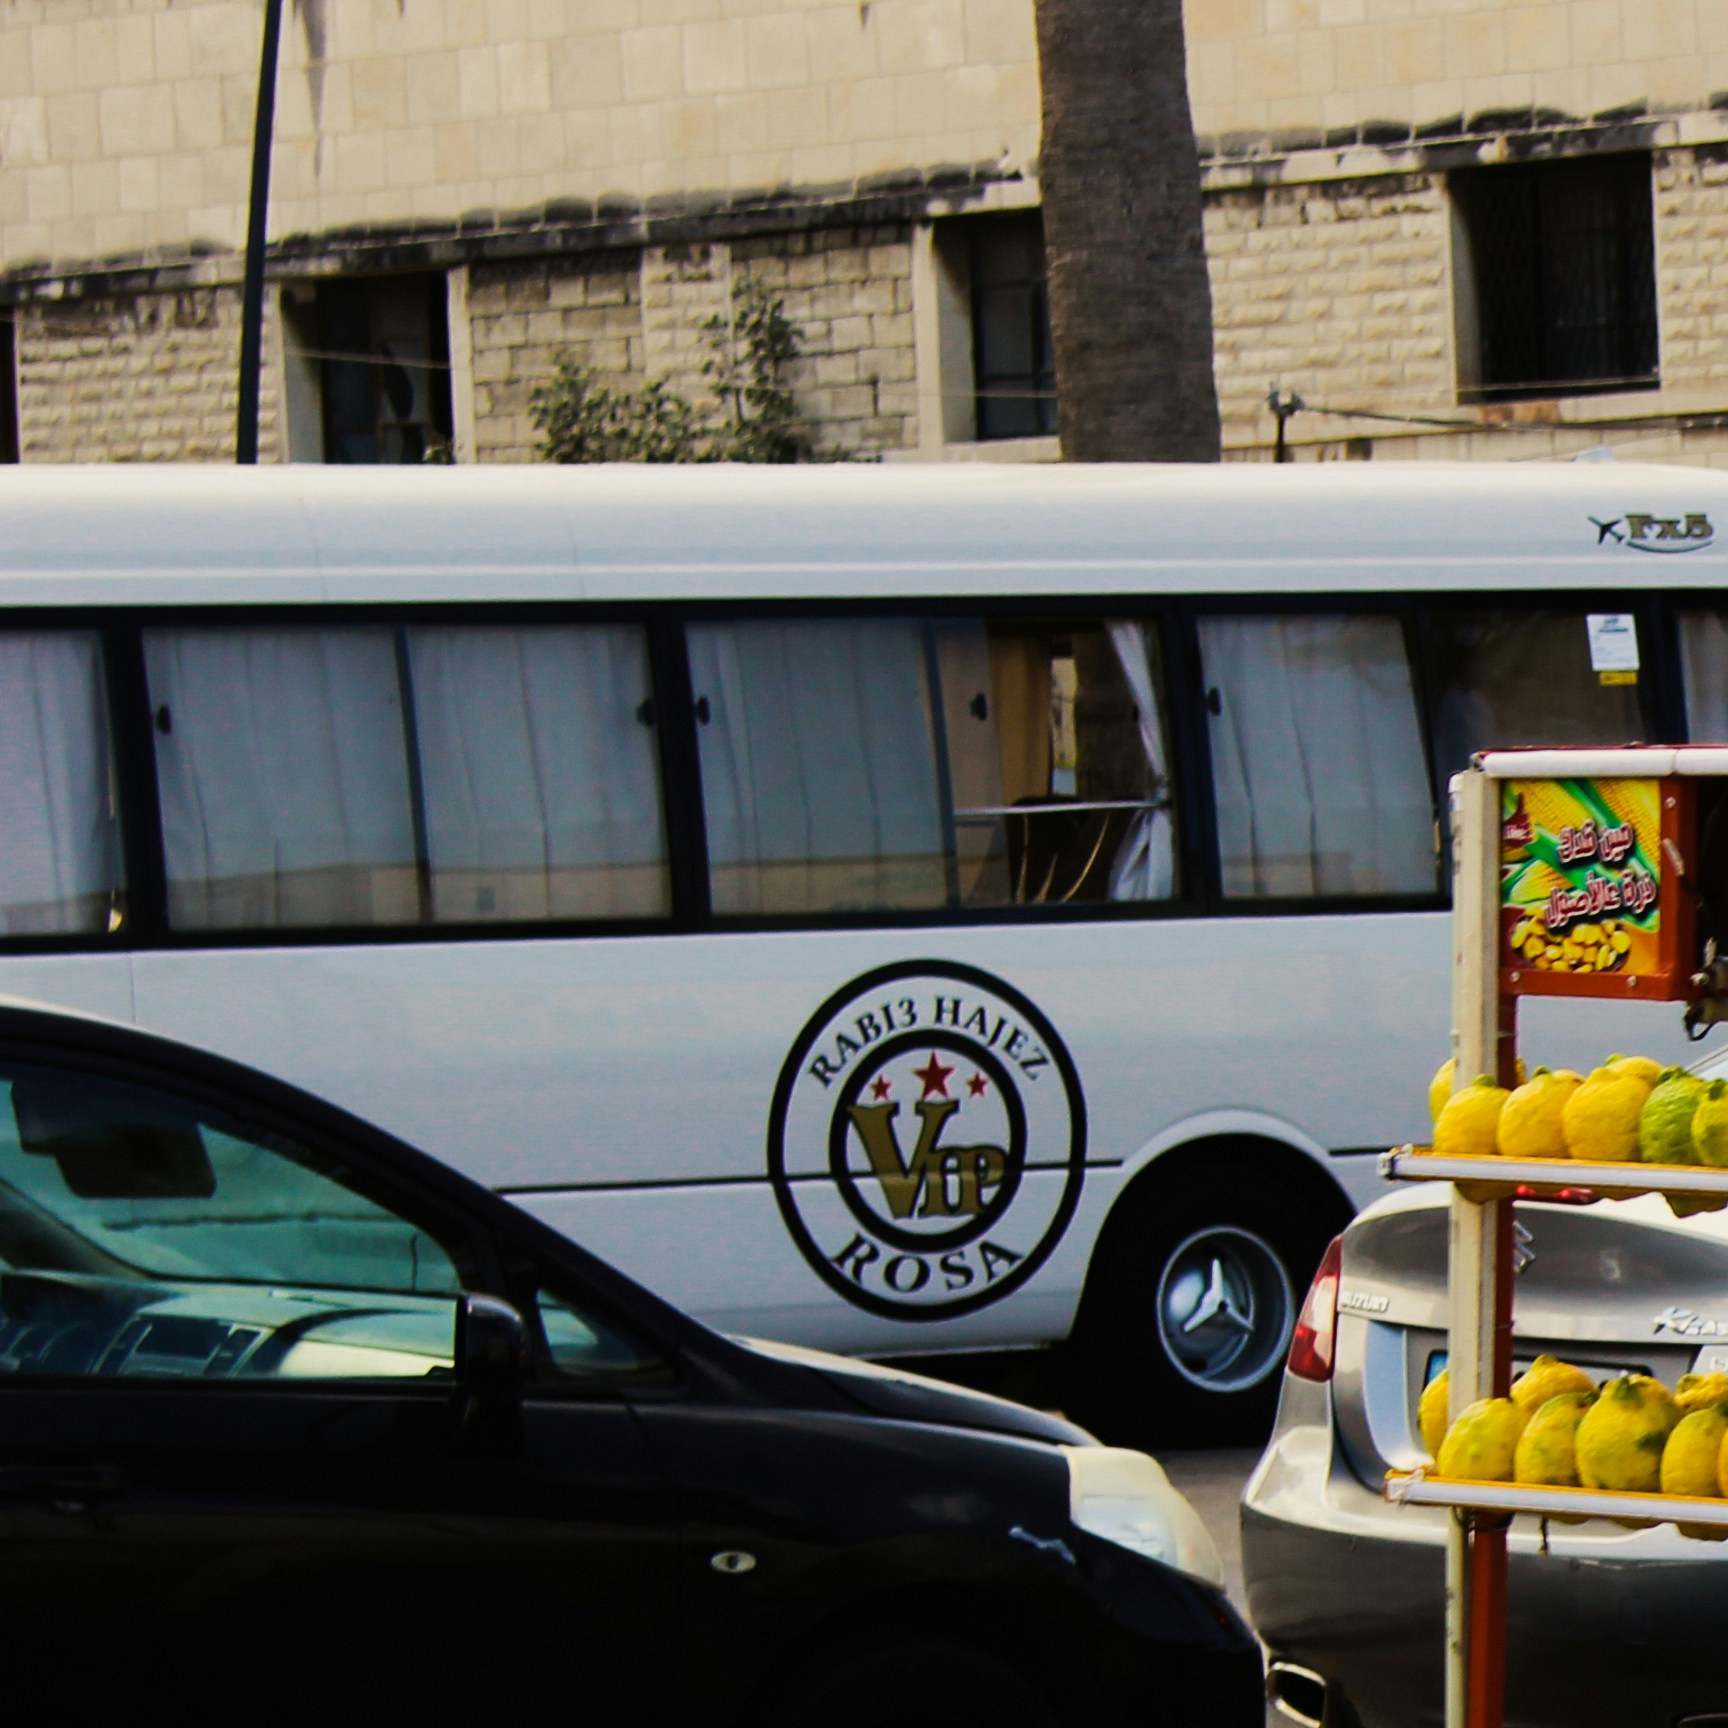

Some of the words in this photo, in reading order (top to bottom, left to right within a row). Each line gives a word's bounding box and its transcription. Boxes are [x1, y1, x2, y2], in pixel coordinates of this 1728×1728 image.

[807, 997, 917, 1089] RABI3
[933, 995, 1056, 1082] HAJEZ
[831, 1232, 1023, 1294] ROSA
